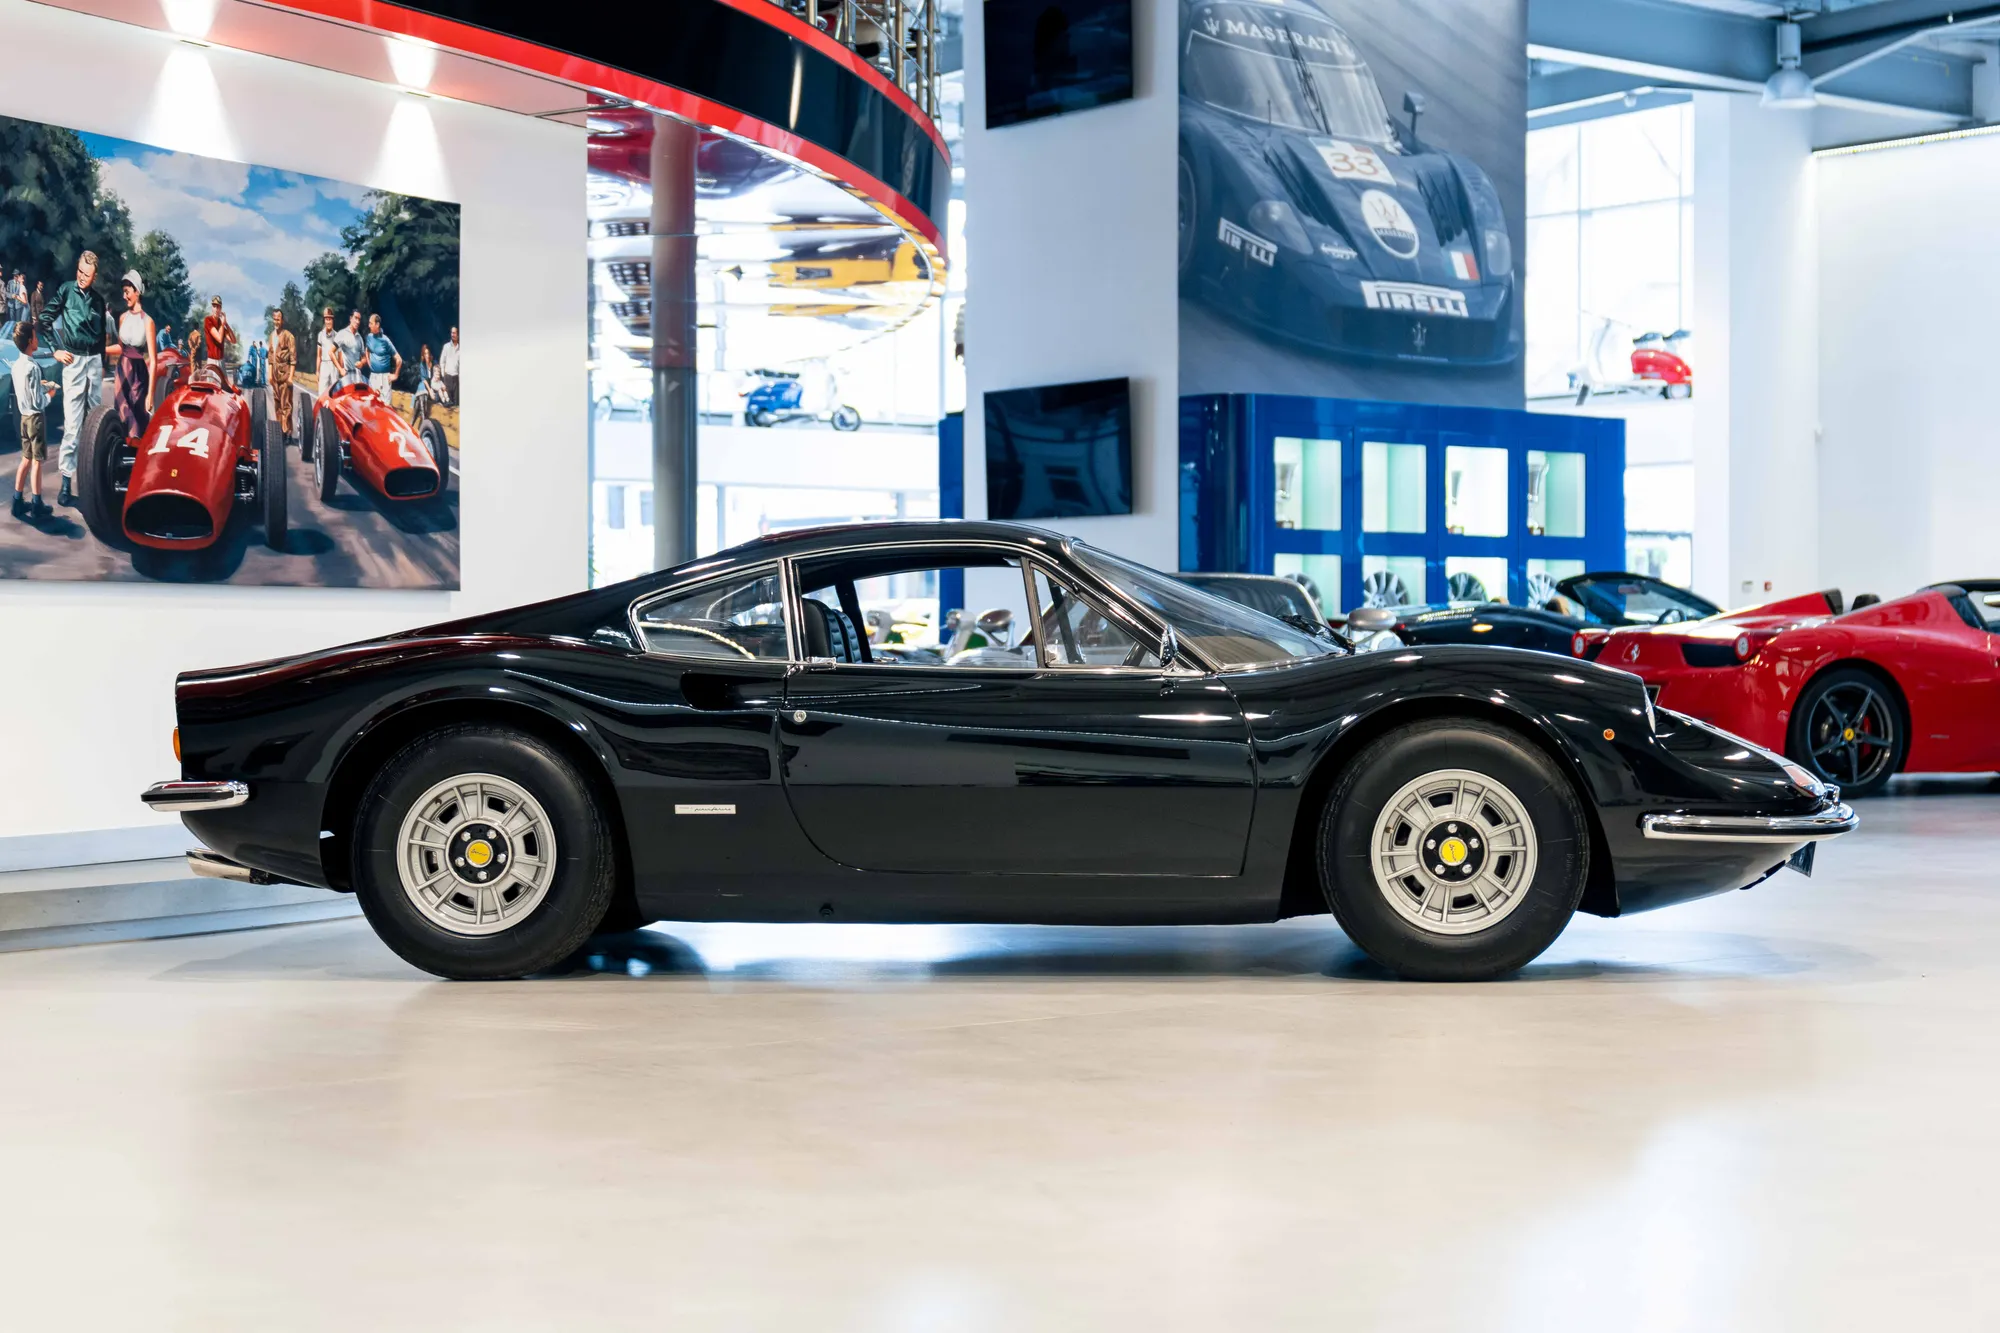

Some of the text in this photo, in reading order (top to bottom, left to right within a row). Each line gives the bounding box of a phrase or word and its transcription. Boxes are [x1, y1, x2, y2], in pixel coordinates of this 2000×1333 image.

[1225, 19, 1344, 56] MASERATI
[1330, 152, 1379, 176] 33
[1360, 280, 1469, 318] PIRELLI
[147, 424, 210, 459] 14
[388, 431, 416, 459] 2
